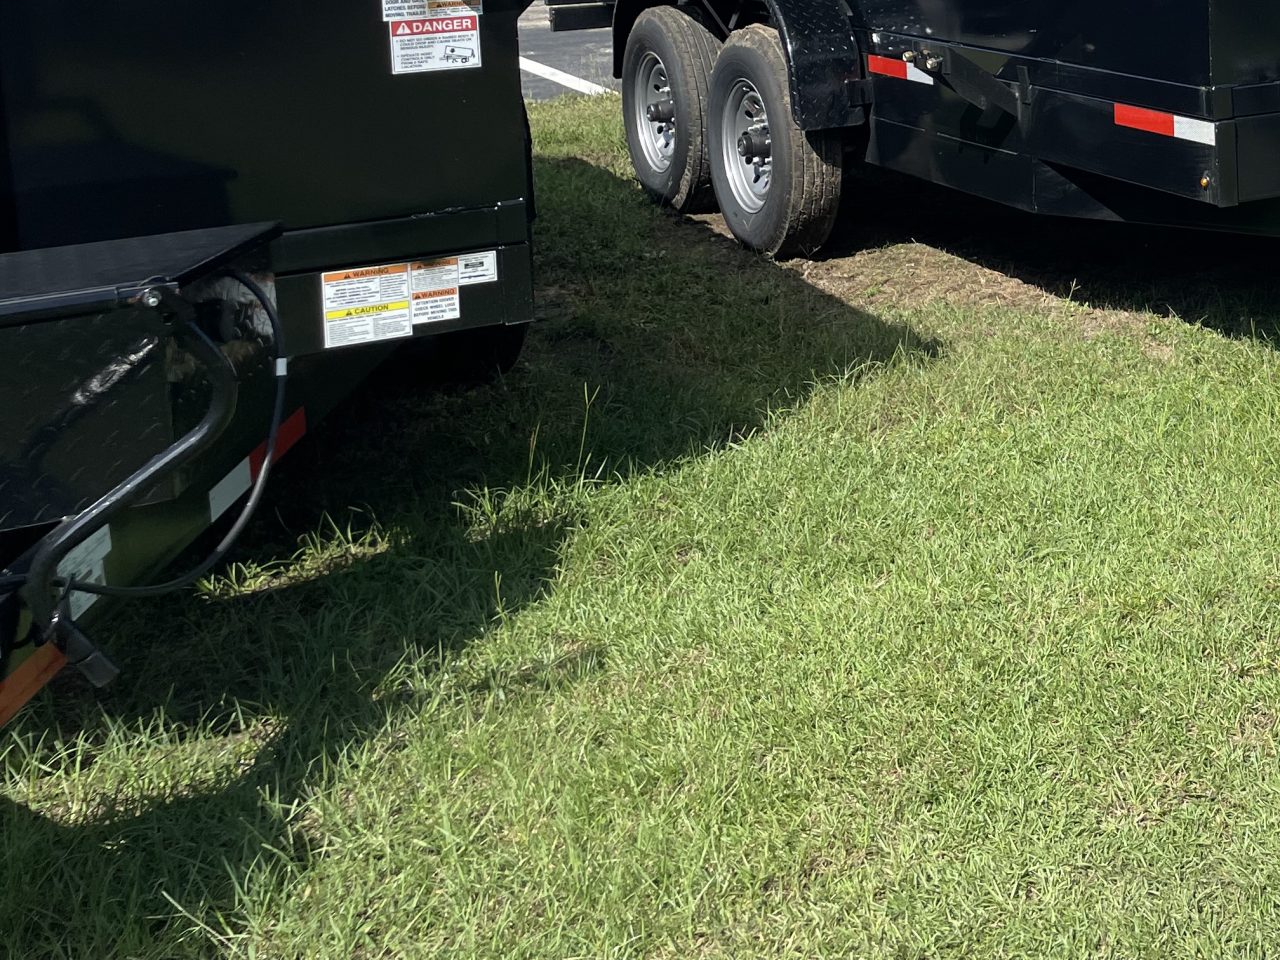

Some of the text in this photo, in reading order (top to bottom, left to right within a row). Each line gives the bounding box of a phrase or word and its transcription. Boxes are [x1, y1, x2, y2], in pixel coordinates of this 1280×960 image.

[412, 18, 472, 33] DANGER
[352, 267, 389, 278] WARNING
[421, 288, 455, 298] WARNING
[354, 303, 389, 314] CAUTION
